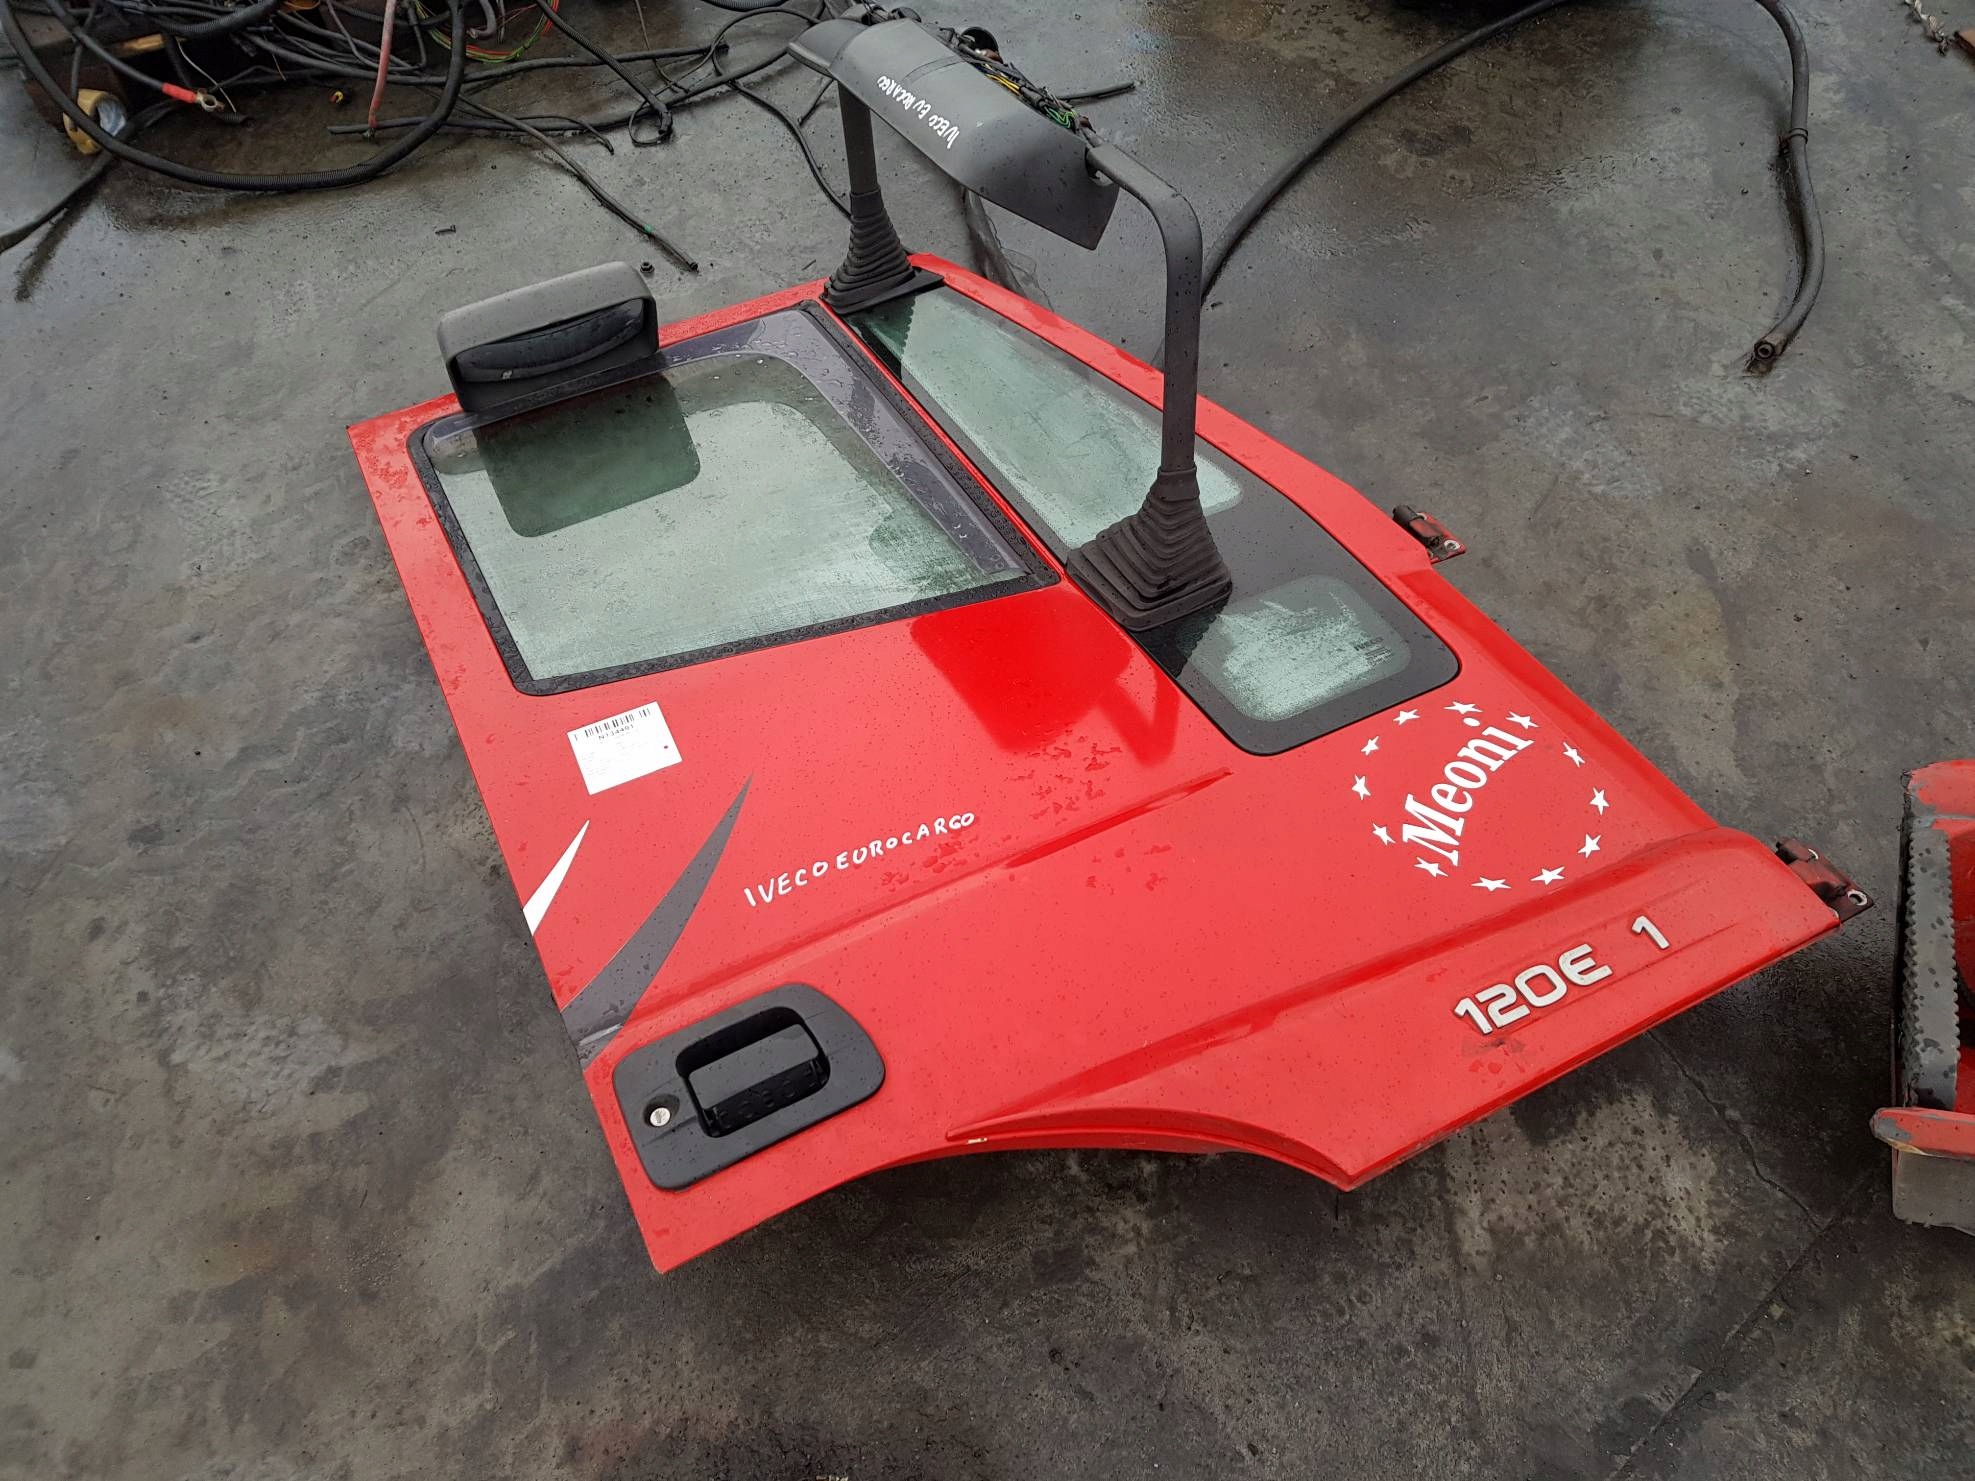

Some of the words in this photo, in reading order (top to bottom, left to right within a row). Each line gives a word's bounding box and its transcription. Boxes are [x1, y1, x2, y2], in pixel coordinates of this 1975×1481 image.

[928, 114, 960, 149] IVECO
[1402, 717, 1535, 867] Meoni
[743, 861, 829, 907] IVECO
[836, 812, 975, 870] EUROCARGO
[1454, 943, 1614, 1034] 120E
[1631, 915, 1671, 949] 1
